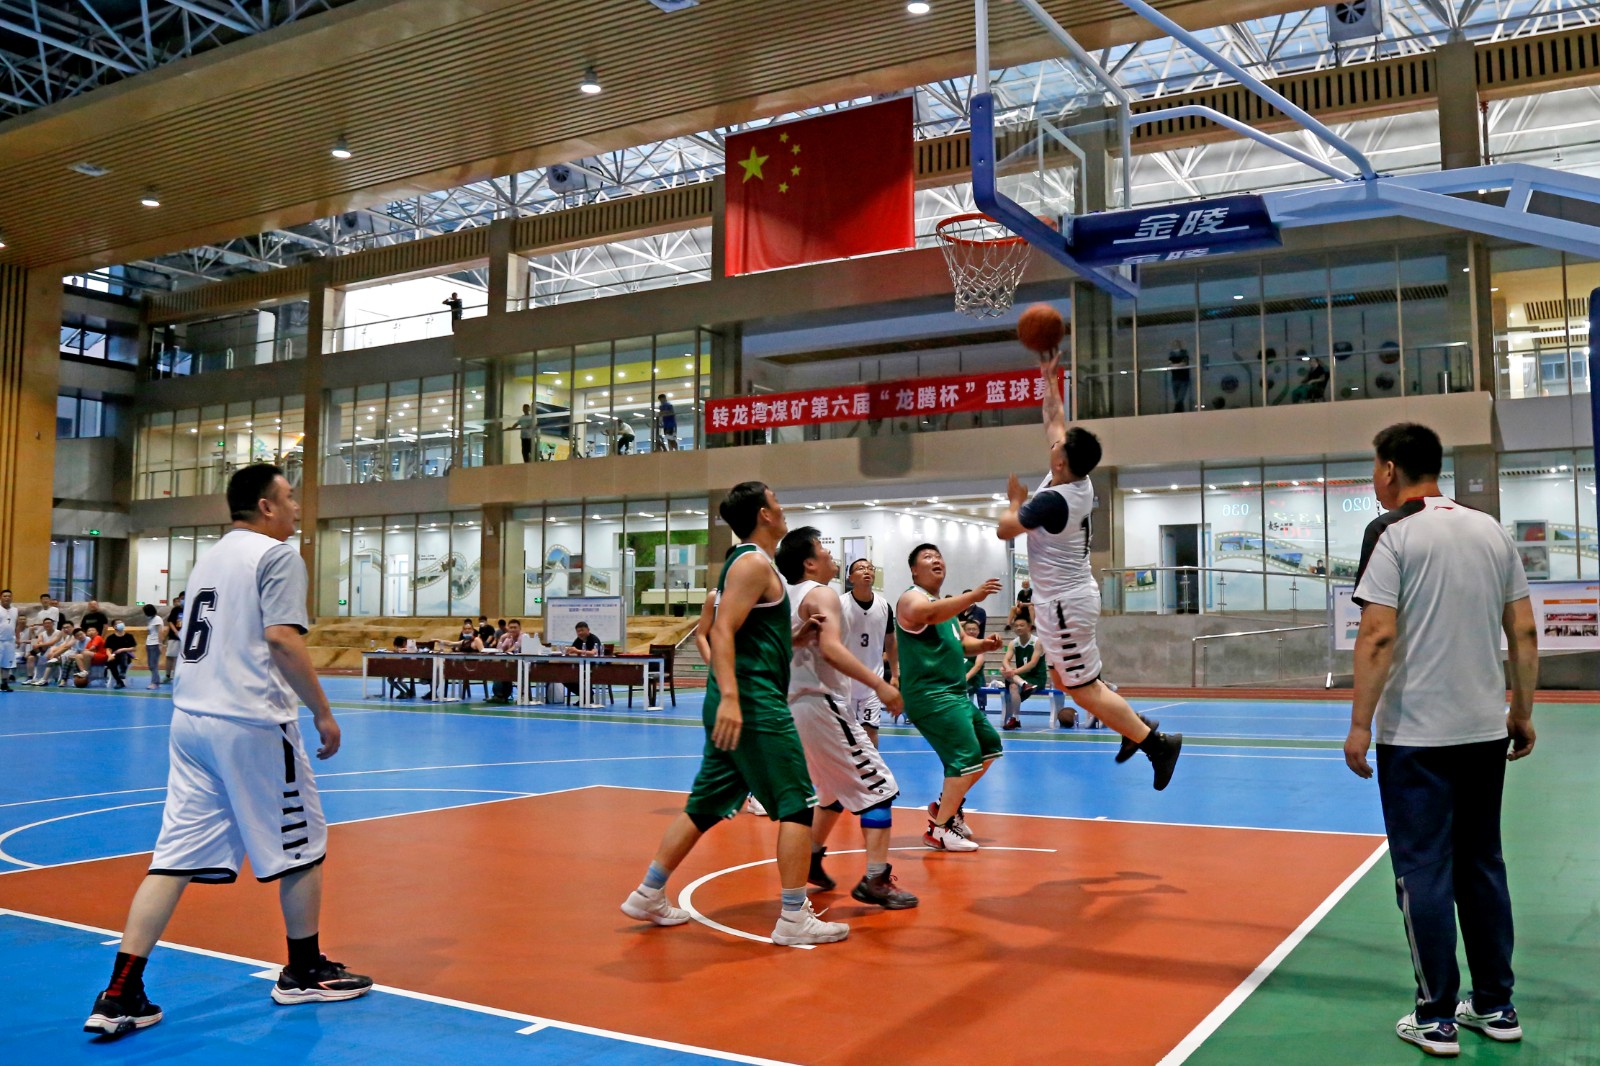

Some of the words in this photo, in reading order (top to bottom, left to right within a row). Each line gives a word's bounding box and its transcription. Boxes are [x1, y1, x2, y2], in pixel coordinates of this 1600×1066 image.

[1113, 207, 1250, 244] 金陵
[180, 587, 219, 664] 6
[860, 633, 870, 648] 3
[863, 708, 872, 721] 3
